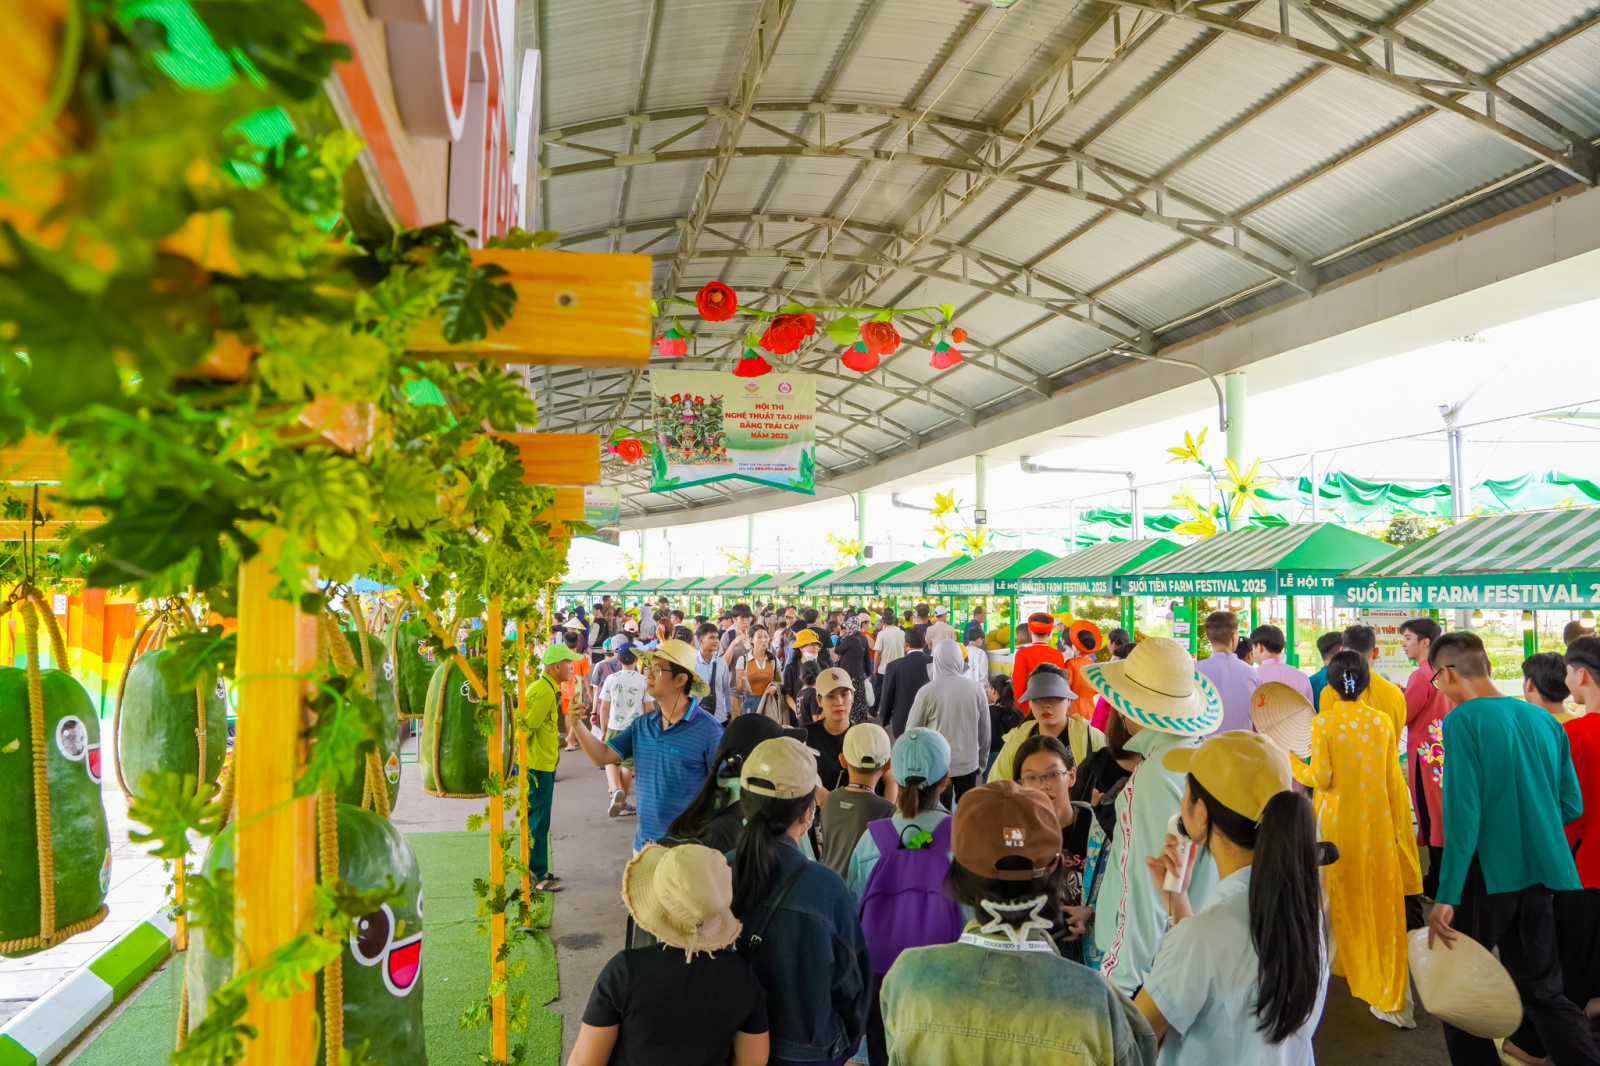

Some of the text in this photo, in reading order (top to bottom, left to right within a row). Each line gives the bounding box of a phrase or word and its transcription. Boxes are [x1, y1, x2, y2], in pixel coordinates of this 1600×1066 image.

[755, 402, 770, 411] HỘI
[725, 411, 747, 420] NGHỆ
[749, 412, 775, 421] THUẬT
[1128, 576, 1146, 592] SUỐI
[1148, 577, 1167, 592] TIÊN
[1169, 580, 1193, 592] FARM
[1196, 579, 1240, 592] FESTIVAL
[1242, 579, 1266, 592] 2025
[1280, 573, 1294, 587] LỄ
[1297, 574, 1318, 590] HỘI
[1046, 582, 1062, 592] FARM
[1064, 582, 1090, 592] FESTIVAL
[1092, 582, 1106, 592] 2025
[1347, 581, 1382, 603] SUỐI
[1386, 582, 1422, 603] TIÊN
[1427, 586, 1478, 603] FARM
[1484, 584, 1584, 603] FESTIVAL
[1385, 646, 1396, 656] 21
